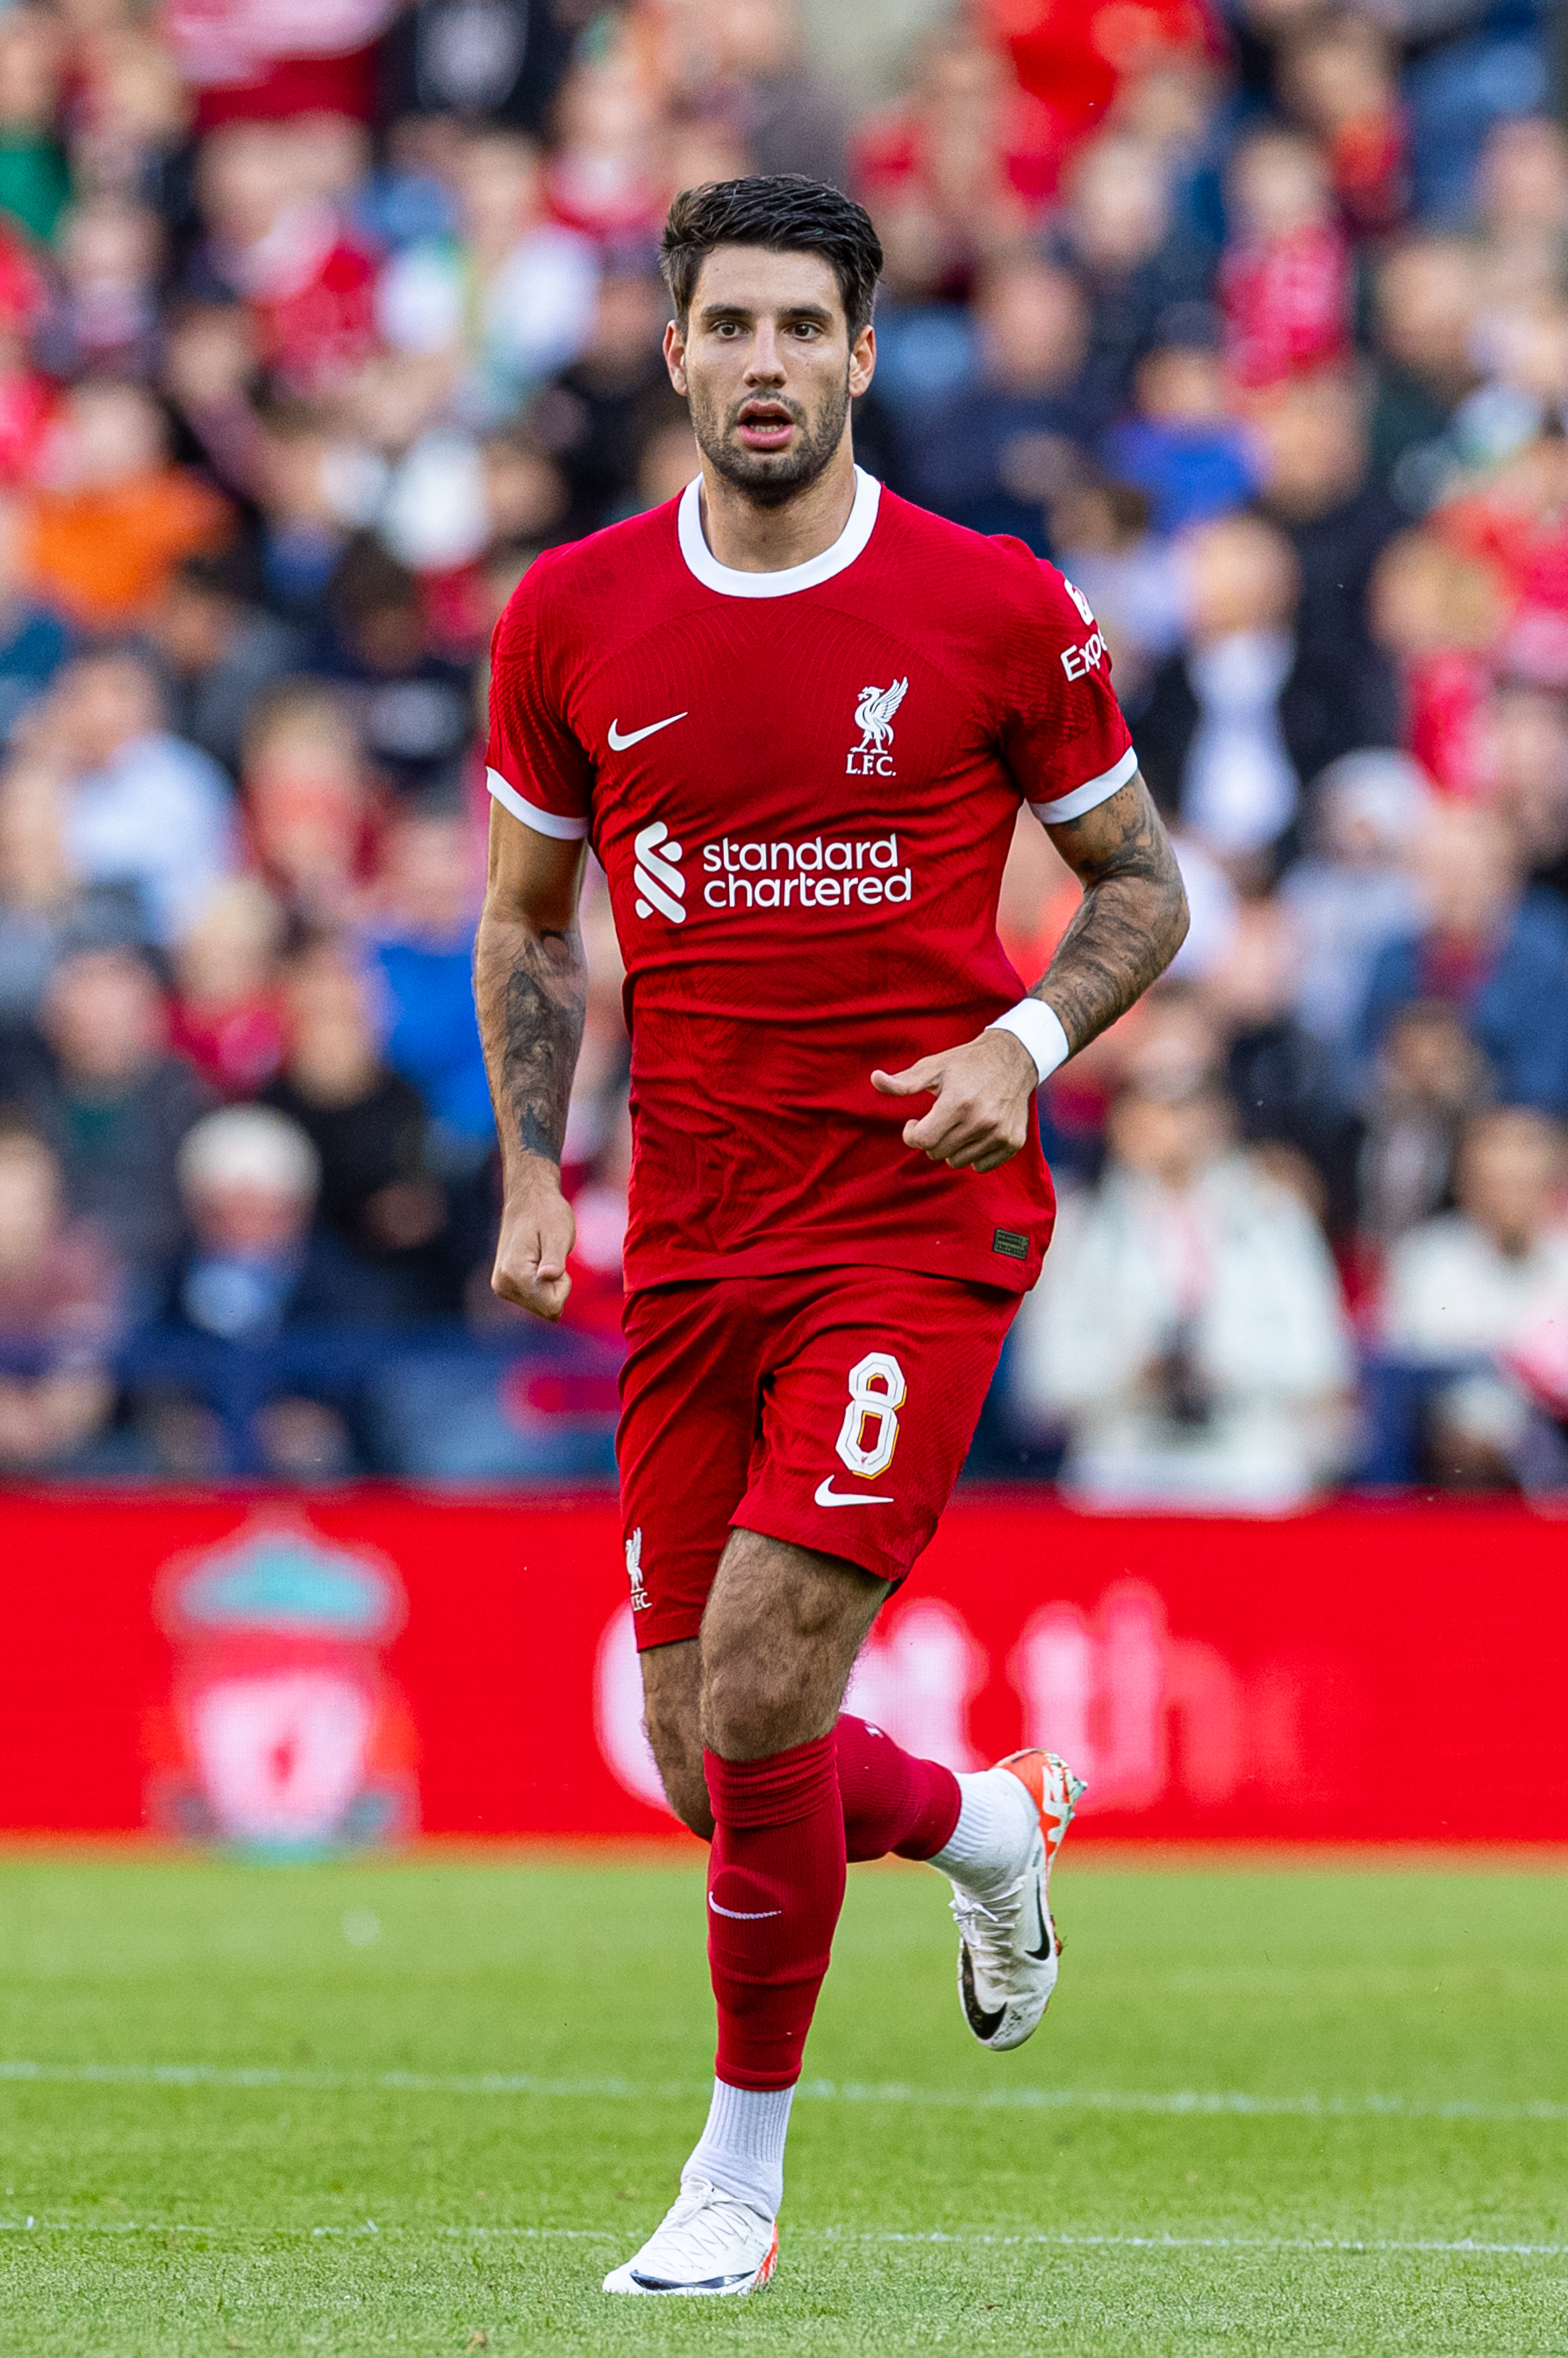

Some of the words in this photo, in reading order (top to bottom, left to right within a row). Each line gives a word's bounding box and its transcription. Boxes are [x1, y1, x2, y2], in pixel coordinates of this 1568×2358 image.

[845, 754, 897, 777] L.F.C.
[703, 833, 899, 871] standard
[704, 867, 912, 907] chartered
[835, 1351, 907, 1480] 8
